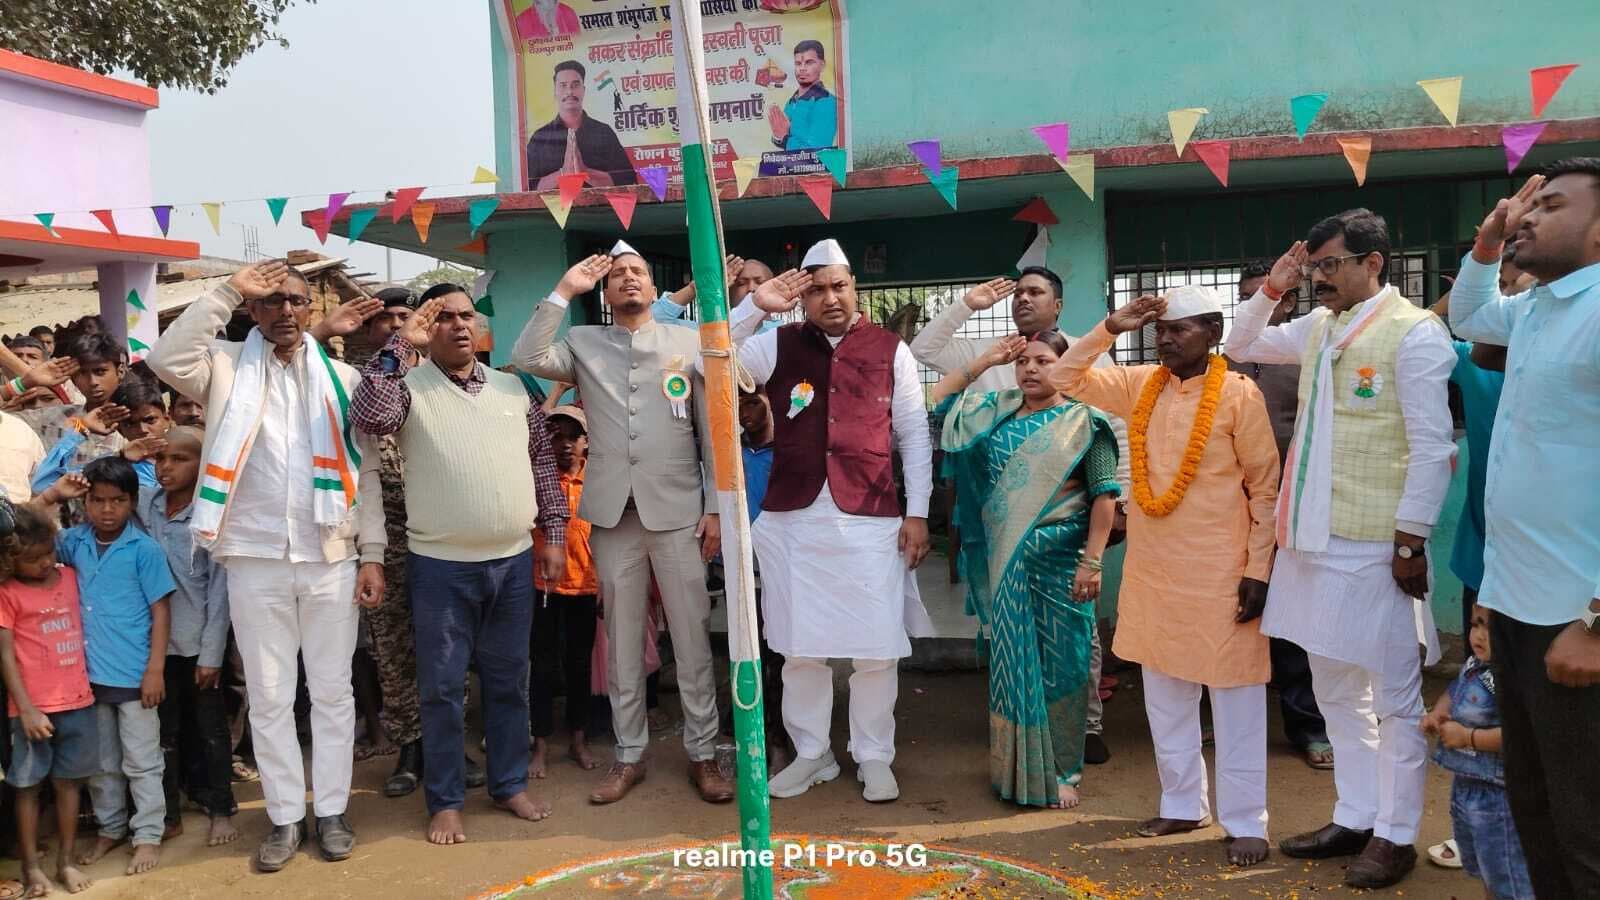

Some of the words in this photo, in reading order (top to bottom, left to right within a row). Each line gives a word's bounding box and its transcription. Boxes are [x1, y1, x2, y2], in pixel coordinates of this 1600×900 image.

[579, 12, 613, 30] समस्त
[588, 43, 625, 63] मकर
[703, 20, 747, 52] रस्वती
[748, 25, 783, 56] पूजा
[621, 69, 641, 94] एवं
[729, 58, 751, 83] की
[613, 102, 666, 132] हार्दिक
